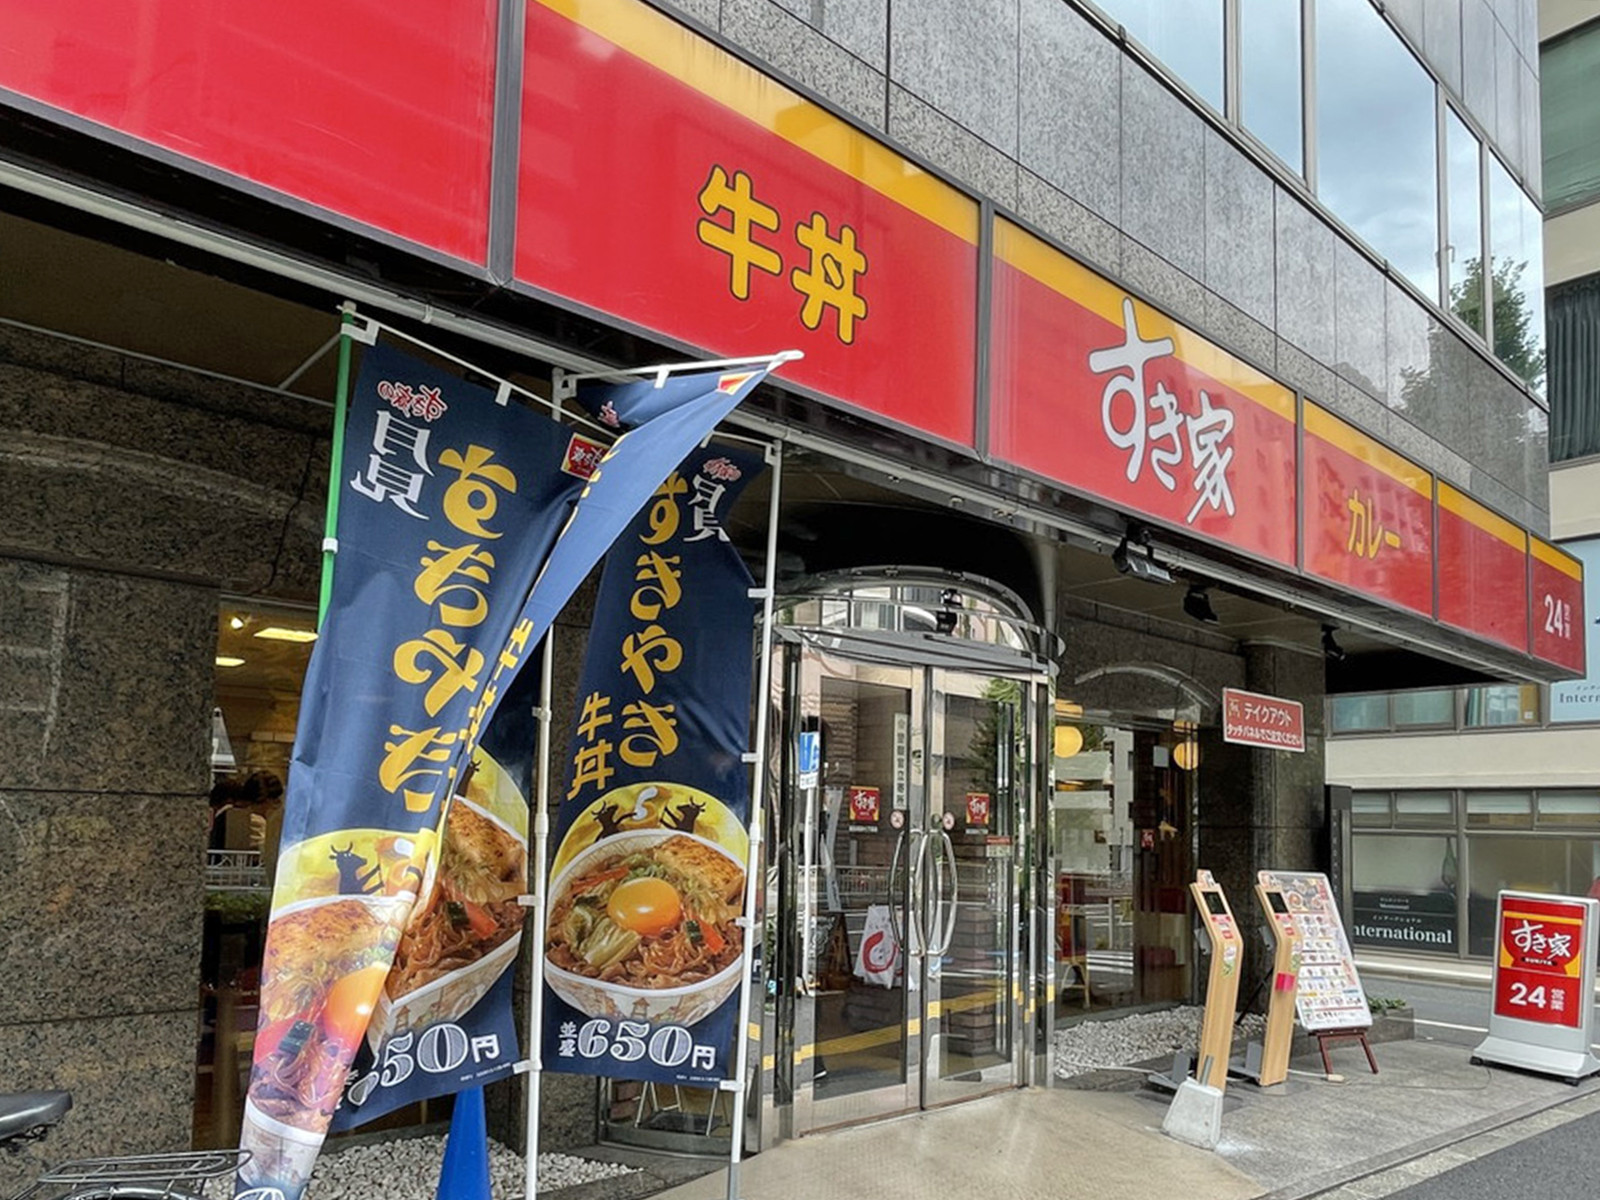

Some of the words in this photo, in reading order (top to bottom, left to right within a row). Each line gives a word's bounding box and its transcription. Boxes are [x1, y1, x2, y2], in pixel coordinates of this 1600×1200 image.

[697, 163, 868, 344] 牛丼
[1088, 297, 1236, 524] すき家
[1347, 489, 1402, 560] カレー
[618, 471, 688, 769] すきやき
[1544, 594, 1563, 637] 24
[1244, 702, 1292, 727] テイクアウト
[567, 691, 615, 801] 牛丼
[1353, 924, 1453, 944] nternational
[1511, 919, 1572, 959] すき家
[1509, 982, 1547, 1009] 24
[577, 1018, 716, 1071] 650円
